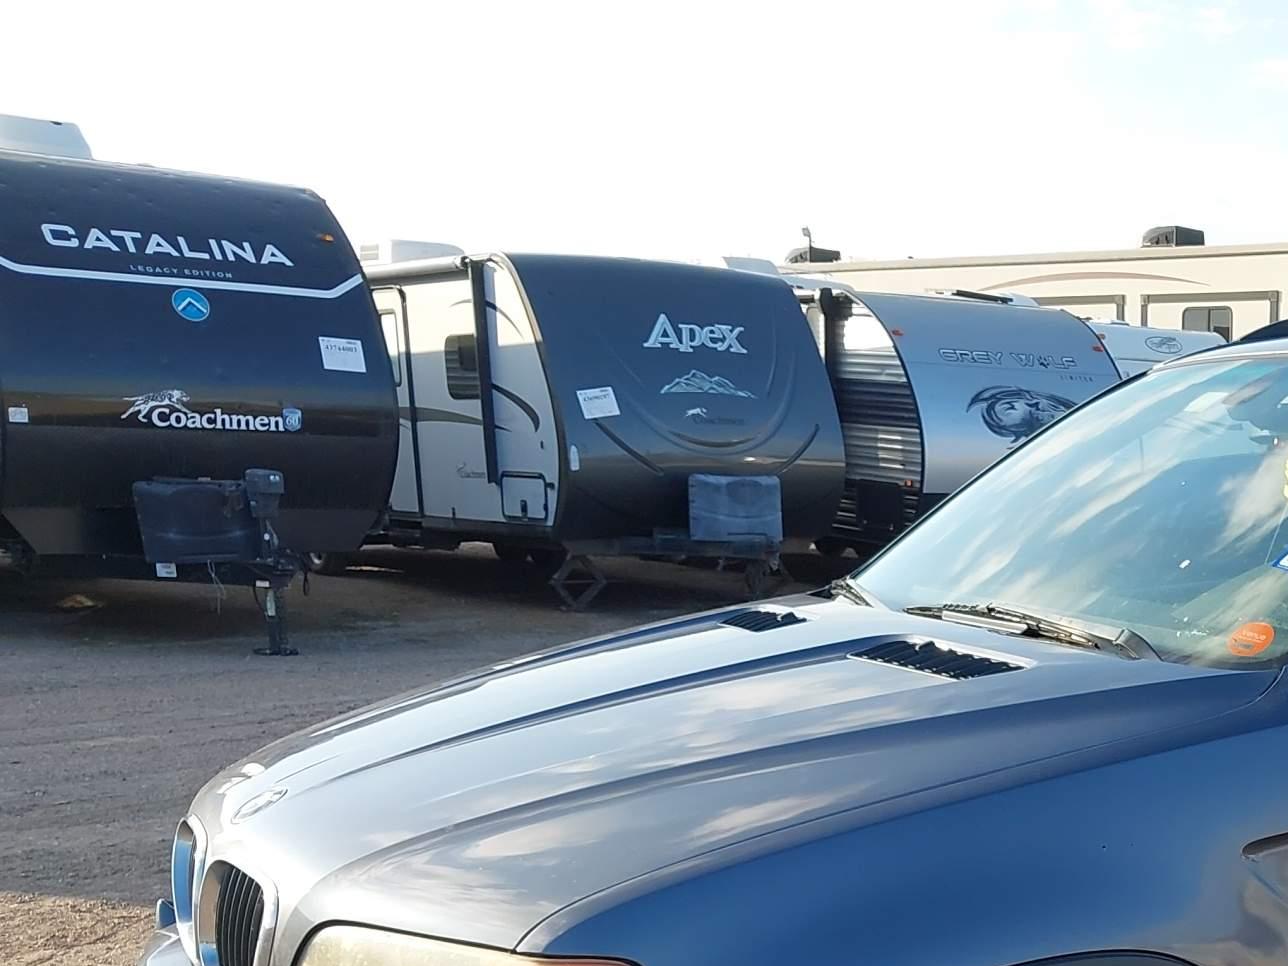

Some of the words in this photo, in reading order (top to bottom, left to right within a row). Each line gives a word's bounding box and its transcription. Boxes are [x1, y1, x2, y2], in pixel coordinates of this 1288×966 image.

[41, 223, 295, 266] CATALINA
[129, 264, 178, 275] LEGACY
[183, 268, 233, 279] EDITION
[643, 313, 748, 354] Apex
[938, 348, 1003, 365] GREY
[152, 407, 285, 432] Coachmen
